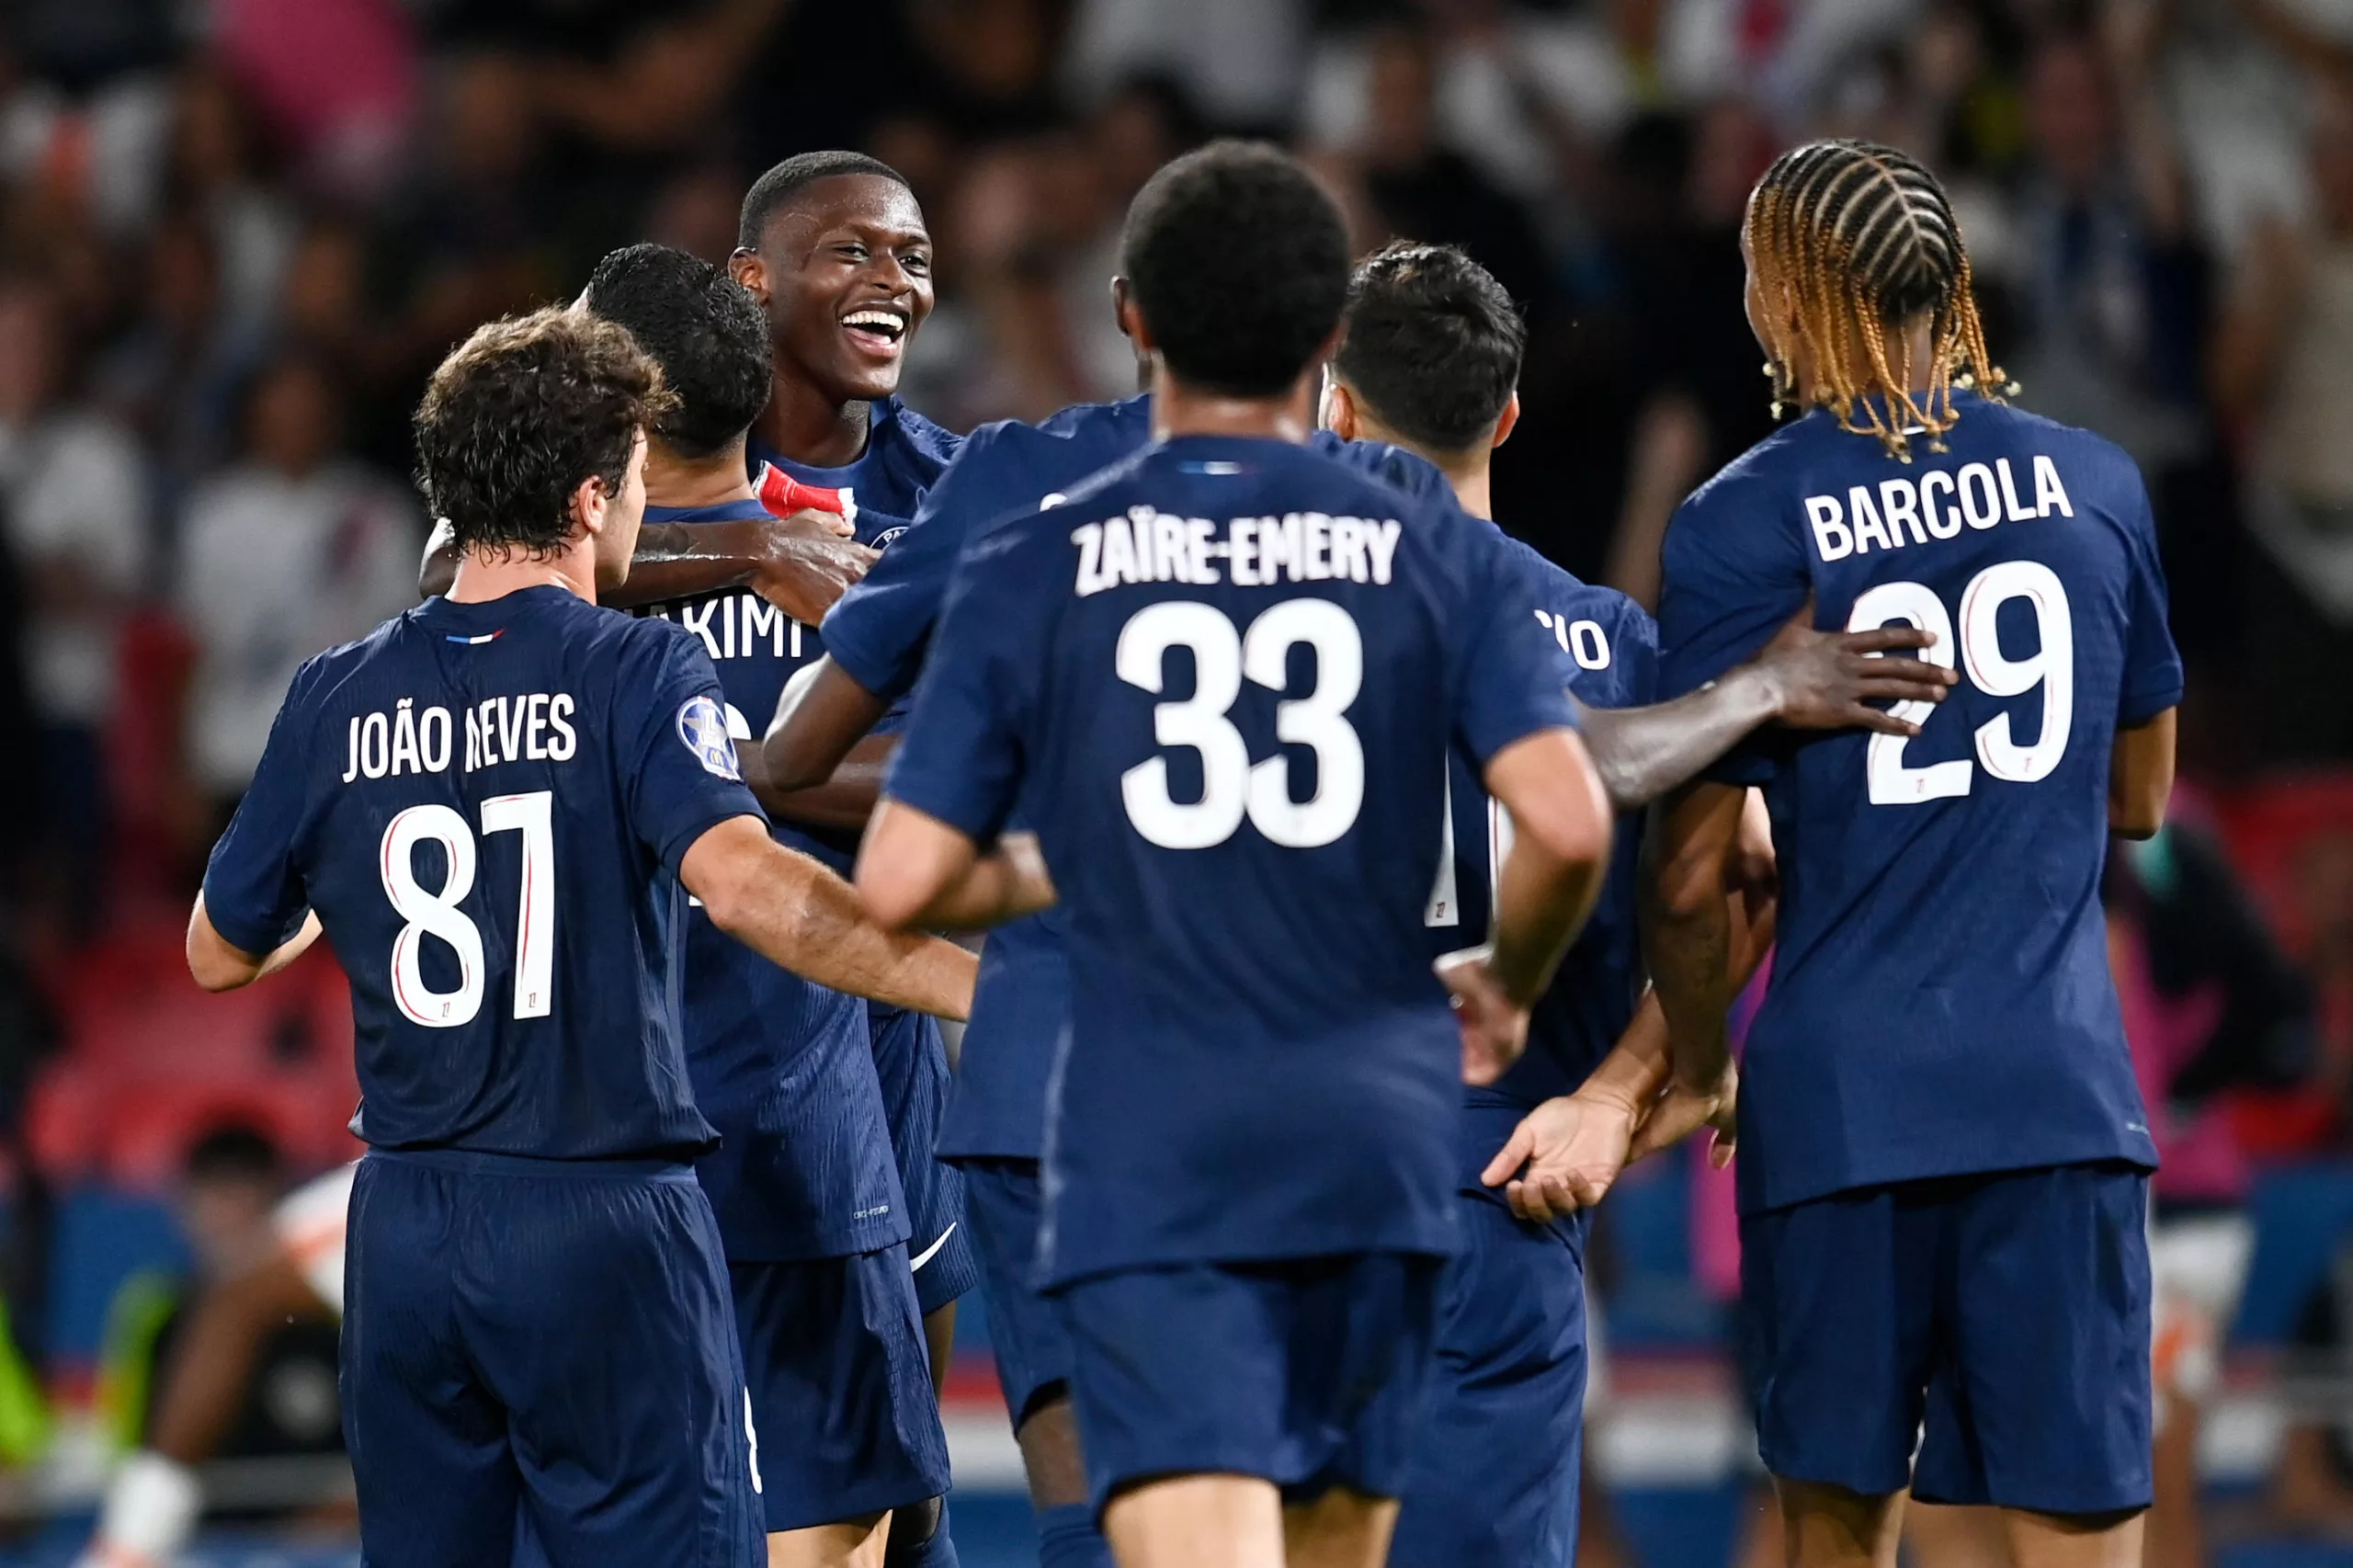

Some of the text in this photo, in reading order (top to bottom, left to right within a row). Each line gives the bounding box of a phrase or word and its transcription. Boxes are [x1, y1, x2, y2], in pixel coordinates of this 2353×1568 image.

[1071, 505, 1402, 597] ZAÏRE-EMERY
[1805, 455, 2074, 562] BARCOLA
[624, 595, 801, 659] KIMI
[1116, 597, 1364, 849] 33
[1847, 560, 2074, 805] 29
[342, 697, 452, 783] JOÃO
[465, 693, 577, 773] NEVES
[380, 790, 555, 1028] 87
